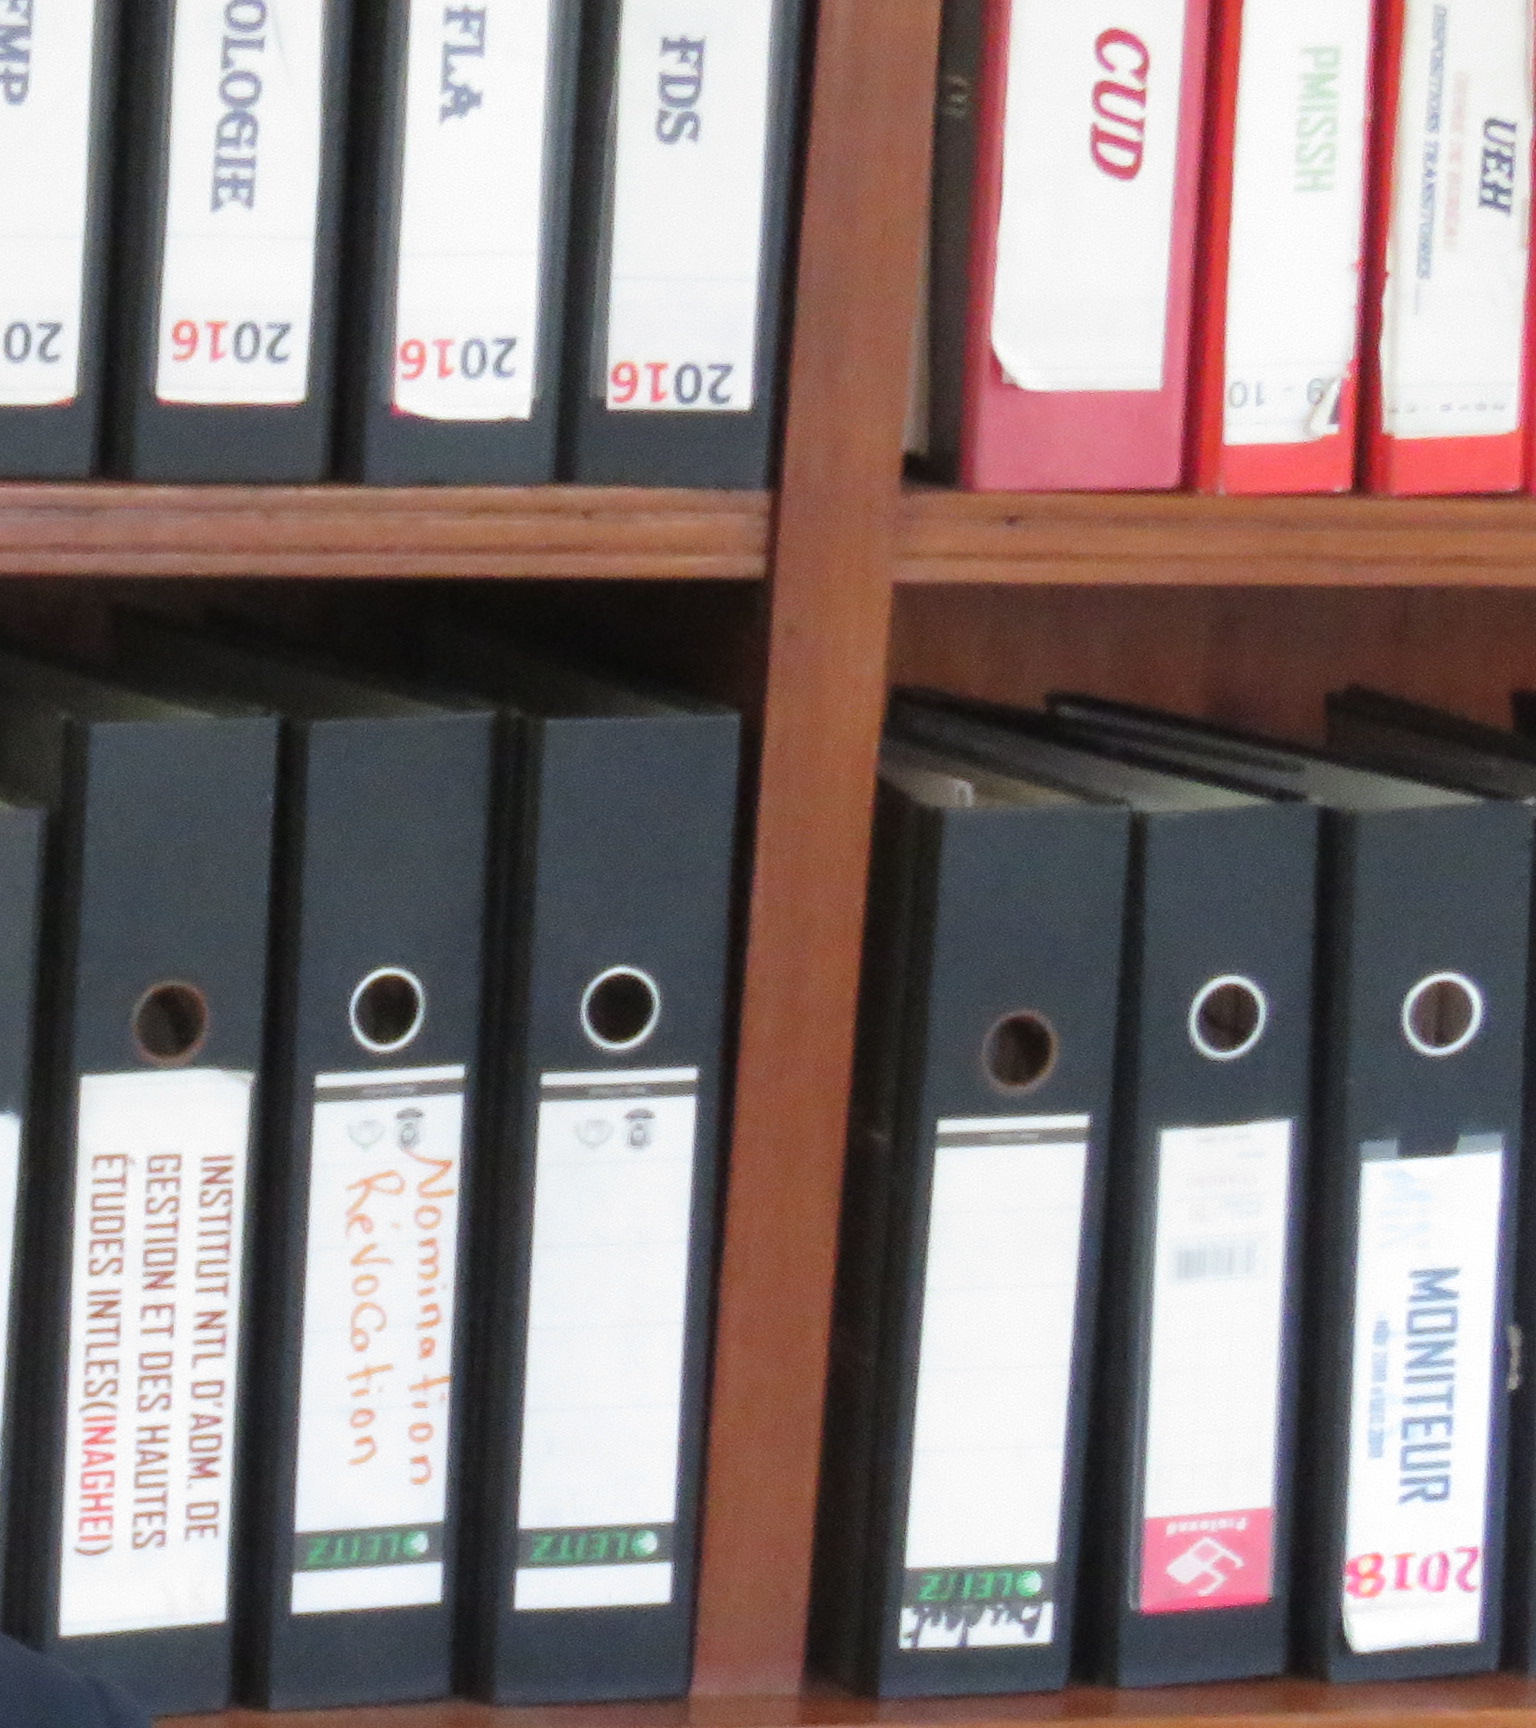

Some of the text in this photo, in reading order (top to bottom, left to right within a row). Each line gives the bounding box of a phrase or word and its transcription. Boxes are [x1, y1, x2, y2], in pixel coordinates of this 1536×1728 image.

[439, 6, 488, 125] FLA
[654, 35, 707, 146] FDS
[1088, 26, 1151, 182] CUD
[1477, 116, 1519, 217] UEH
[171, 319, 293, 365] 2016
[399, 337, 518, 381] 2016
[609, 360, 734, 407] 2016
[193, 1153, 236, 1298] INSTITUT
[131, 1153, 182, 1551] GESTION ET DES HAUTES
[192, 1311, 228, 1370] NTL
[1397, 1266, 1460, 1506] MONITEUR
[184, 1502, 219, 1542] DE
[306, 1532, 406, 1562] LEITZ
[530, 1533, 630, 1562] LEITZ
[922, 1568, 1016, 1603] LEITZ
[1345, 1546, 1481, 1599] 2018
